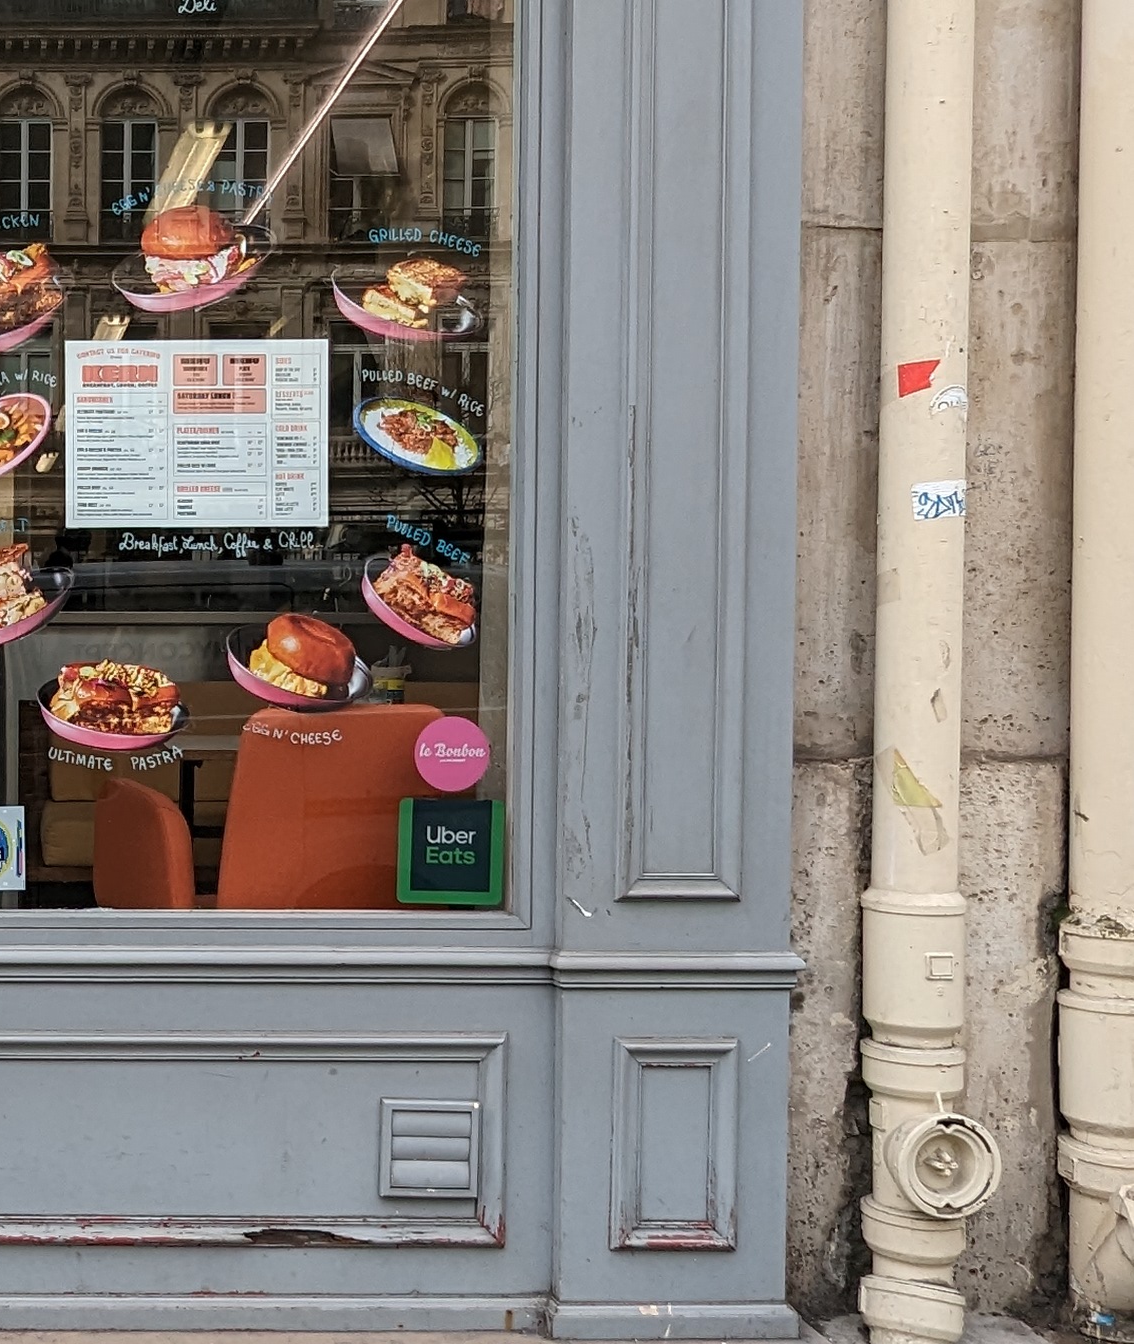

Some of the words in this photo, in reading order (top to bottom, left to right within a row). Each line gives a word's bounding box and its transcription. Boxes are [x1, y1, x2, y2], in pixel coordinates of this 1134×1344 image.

[111, 193, 138, 216] EGG
[368, 227, 422, 244] GRILLED
[429, 229, 482, 257] CHEESE
[32, 370, 57, 388] RICE
[361, 369, 403, 382] PULLED
[406, 373, 438, 391] BEEF
[457, 393, 485, 417] RICE
[223, 532, 260, 558] Coffee
[386, 514, 432, 547] PULLED
[435, 538, 471, 565] BEEF
[290, 729, 343, 746] CHEESE
[48, 746, 114, 772] ULTIMATE
[433, 742, 486, 758] Bonbon
[426, 825, 476, 845] Uber
[425, 846, 476, 865] Eats
